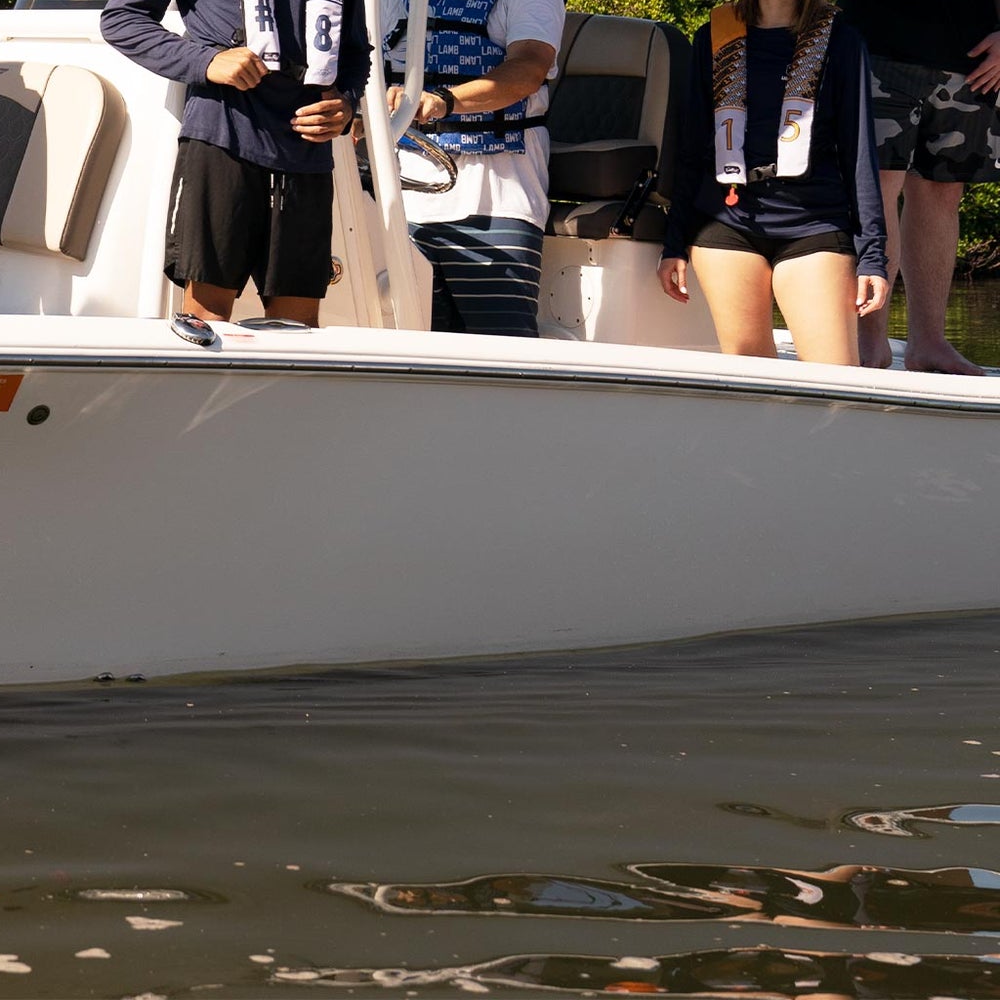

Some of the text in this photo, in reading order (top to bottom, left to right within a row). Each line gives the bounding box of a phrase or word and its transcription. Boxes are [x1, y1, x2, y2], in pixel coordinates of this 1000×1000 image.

[465, 0, 488, 10] LAMB
[442, 7, 464, 17] LAMB
[314, 14, 333, 52] 8
[459, 35, 481, 46] LAMB
[438, 45, 459, 55] LAMB
[481, 46, 503, 56] LAMB
[459, 55, 481, 65] LAMB
[437, 64, 459, 75] LAMB
[780, 109, 802, 142] 5
[461, 133, 483, 145] LAMB
[721, 118, 733, 151] 1
